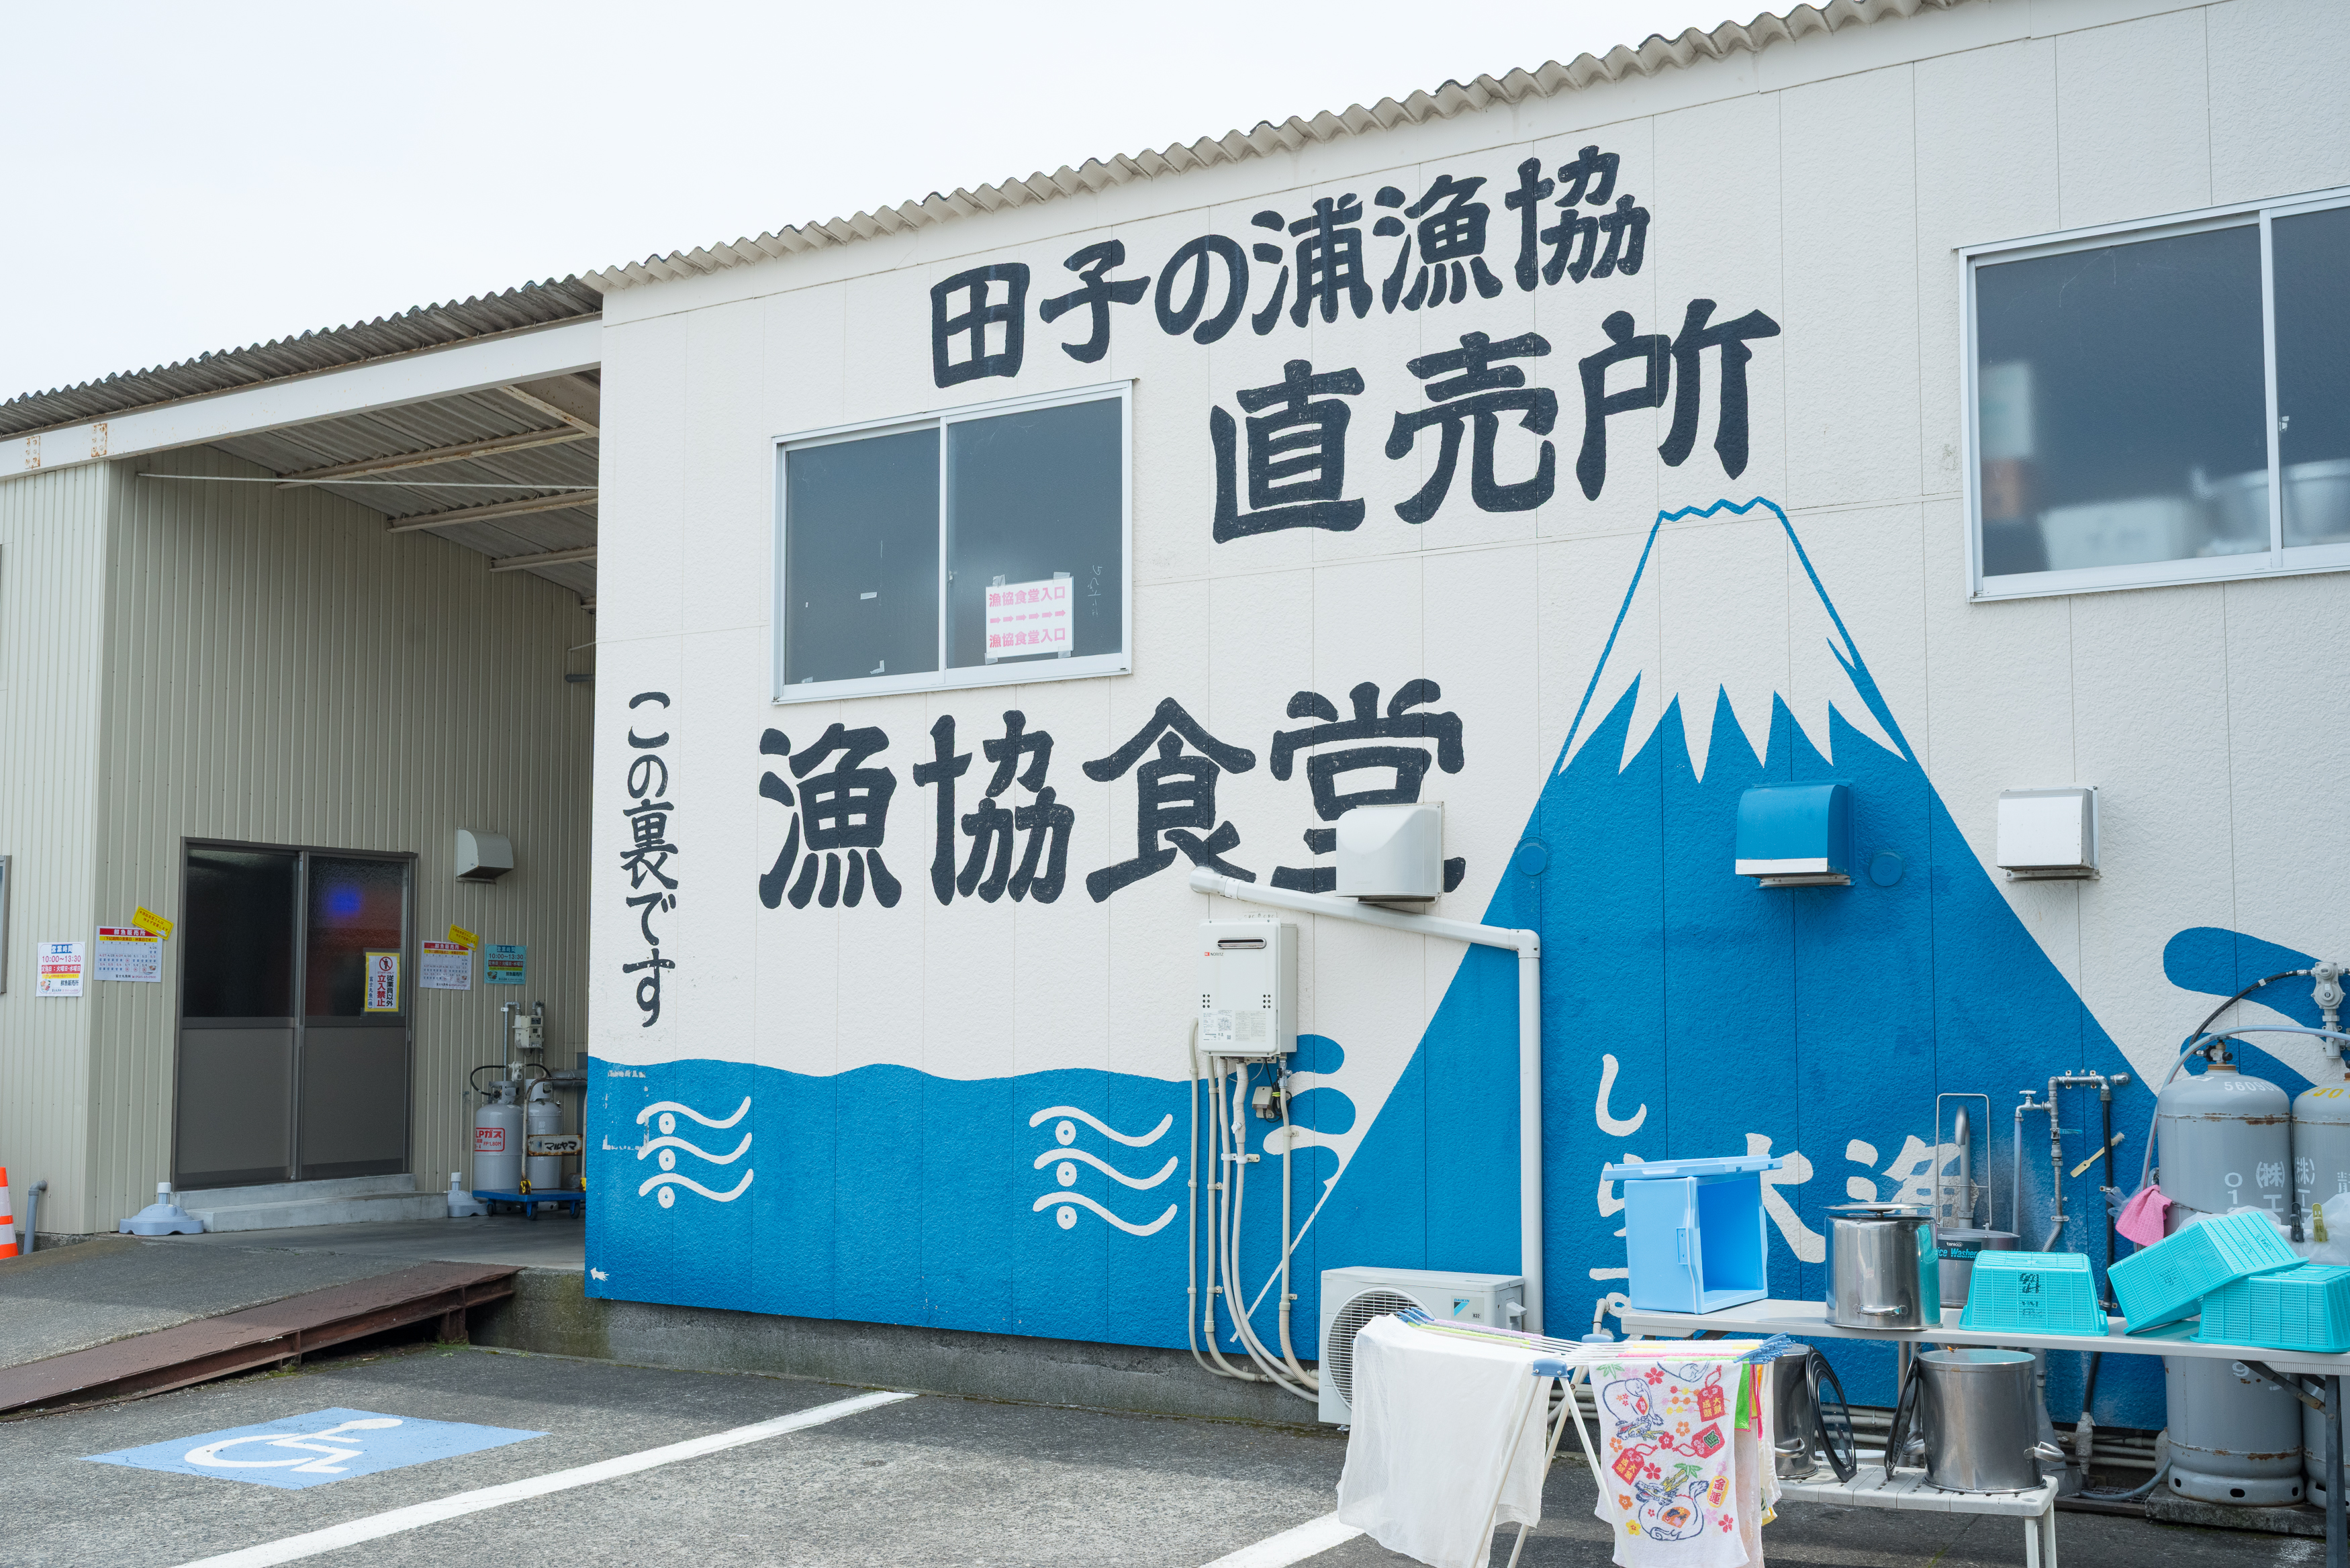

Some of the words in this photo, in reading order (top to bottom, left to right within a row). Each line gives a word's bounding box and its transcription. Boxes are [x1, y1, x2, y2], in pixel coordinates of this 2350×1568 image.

[931, 146, 1650, 389] 田子の浦漁協
[1210, 299, 1781, 544] 直売所
[989, 586, 1066, 607] 漁協食堂入口
[989, 628, 1066, 648] 漁協食堂入口
[759, 679, 1466, 910] 漁協食堂
[620, 692, 679, 1028] この裏です
[51, 945, 73, 953] 営業時間
[377, 975, 386, 1007] 立入禁止
[386, 975, 394, 1007] 従業員以外
[475, 1130, 502, 1138] LPガス
[545, 1141, 577, 1150] マルヤマ
[1950, 1248, 1978, 1259] Washer
[1709, 1477, 1726, 1505] 金運
